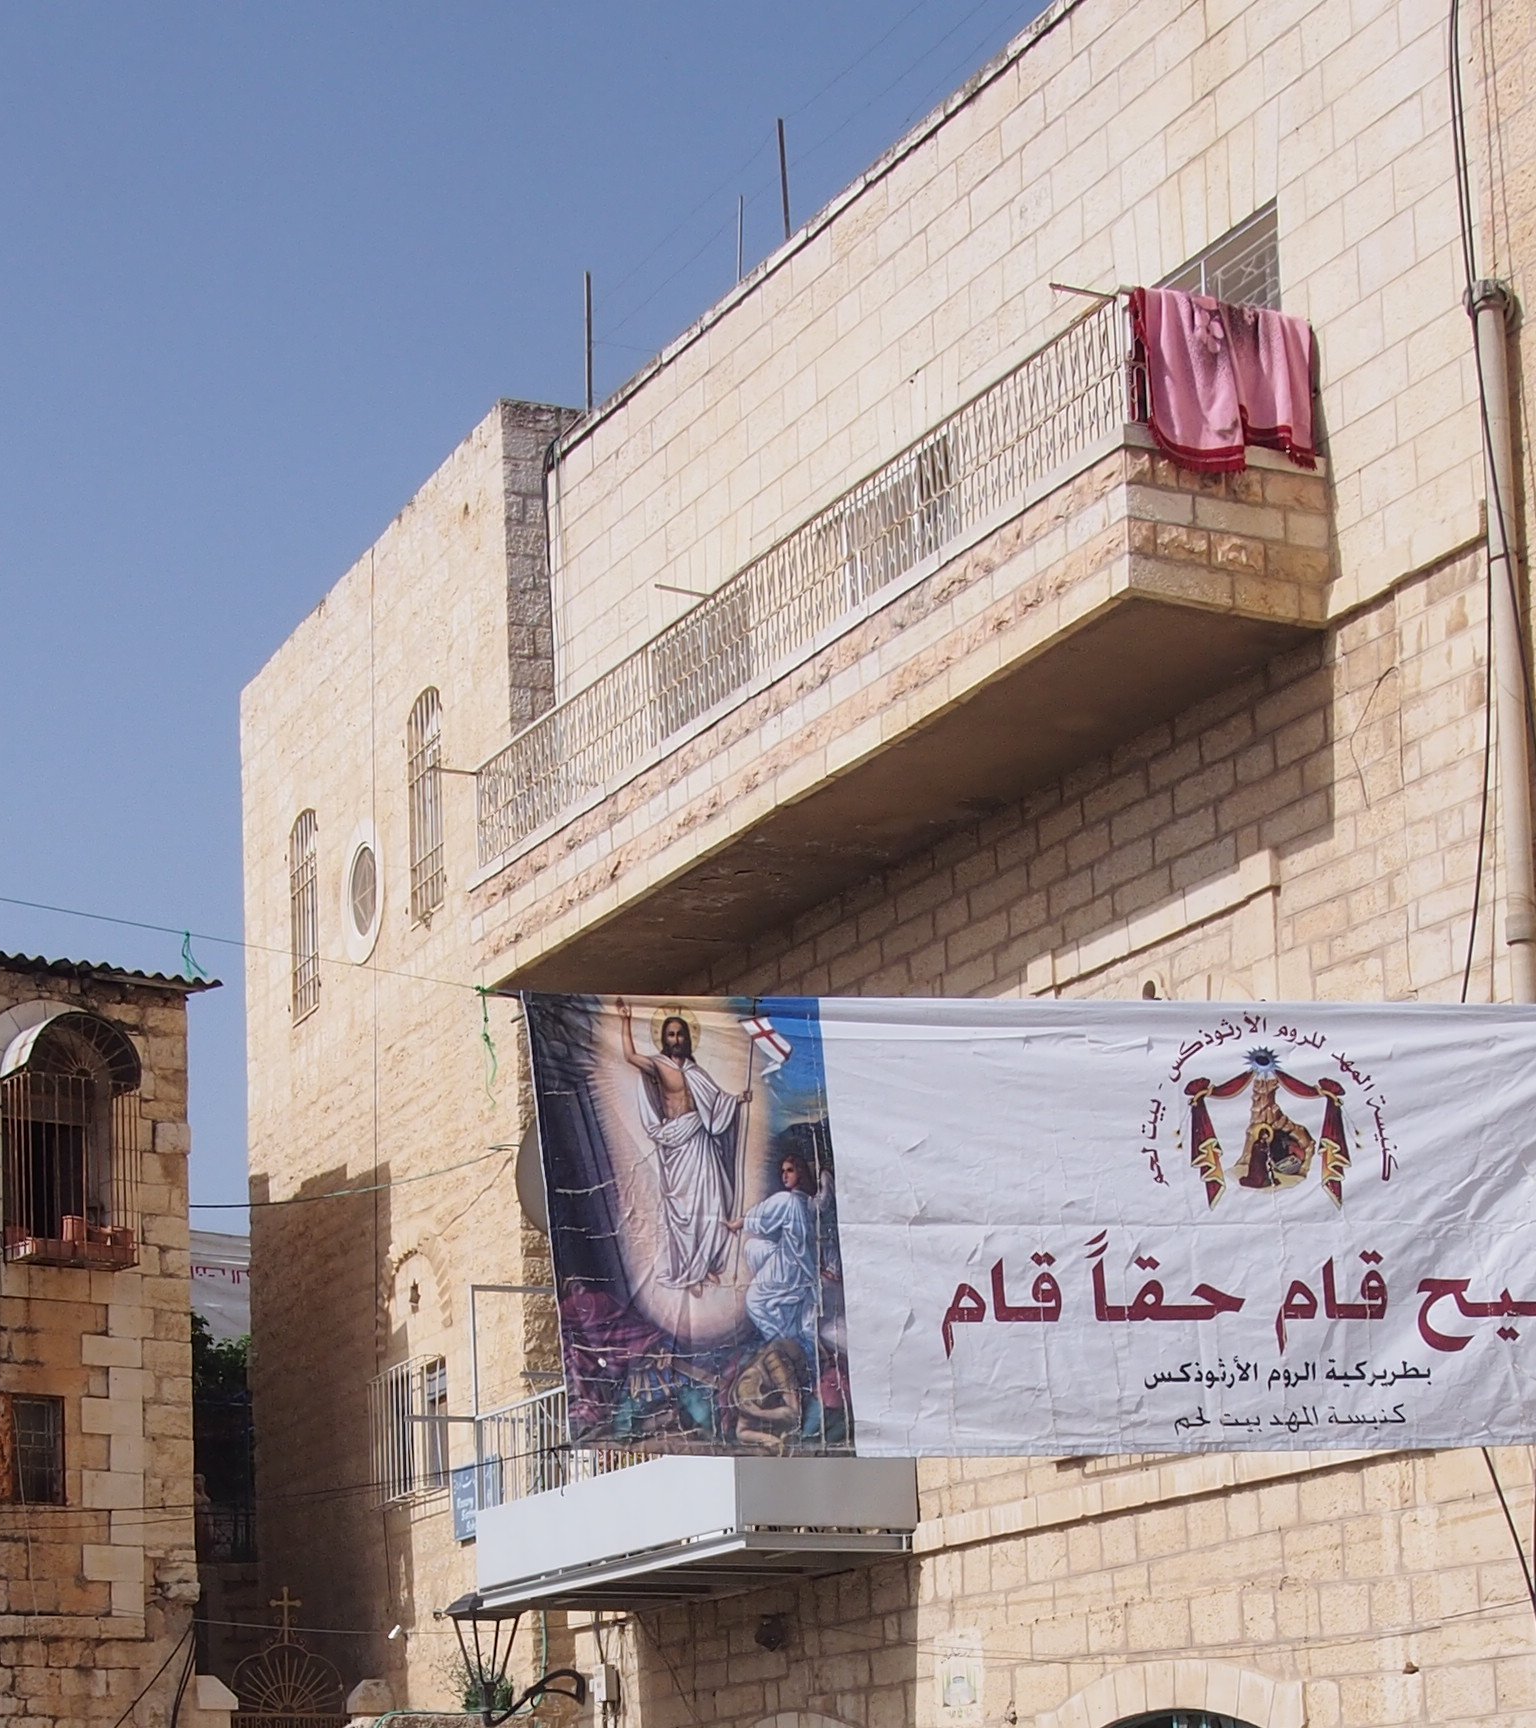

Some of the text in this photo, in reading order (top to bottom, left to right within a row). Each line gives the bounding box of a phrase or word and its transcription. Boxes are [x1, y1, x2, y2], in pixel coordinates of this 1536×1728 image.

[1273, 1024, 1327, 1050] للروم
[1331, 1051, 1376, 1092] المهد
[1141, 1098, 1166, 1140] بيت
[1365, 1094, 1399, 1182] كنيسة
[1141, 1146, 1170, 1188] لحم
[942, 1251, 1062, 1360] قام
[1275, 1249, 1389, 1357] قام
[1267, 1360, 1316, 1391] الروم
[1324, 1359, 1432, 1388] بطريركية
[1174, 1403, 1407, 1437] كنيسة المهد بيت لحم
